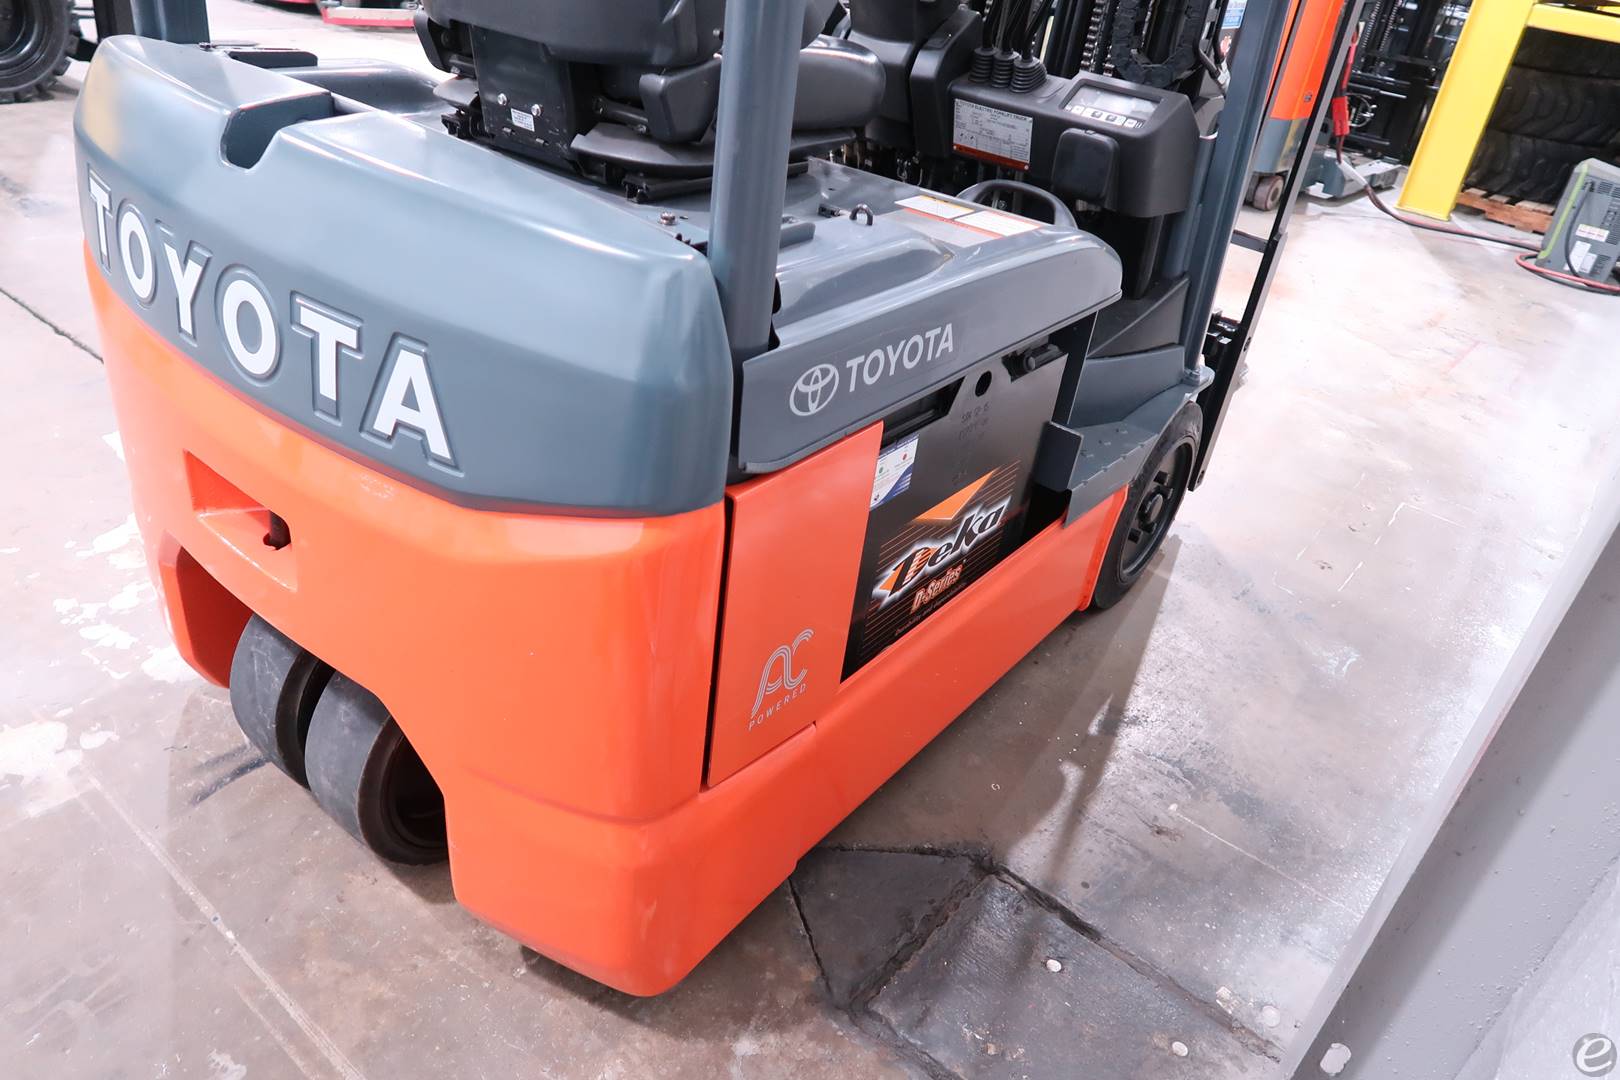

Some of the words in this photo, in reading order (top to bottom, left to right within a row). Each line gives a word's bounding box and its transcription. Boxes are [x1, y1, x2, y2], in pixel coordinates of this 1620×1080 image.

[88, 174, 453, 461] TOYOTA
[846, 322, 954, 393] TOYOTA
[879, 502, 1007, 600] Deka
[747, 683, 807, 732] POWERED
